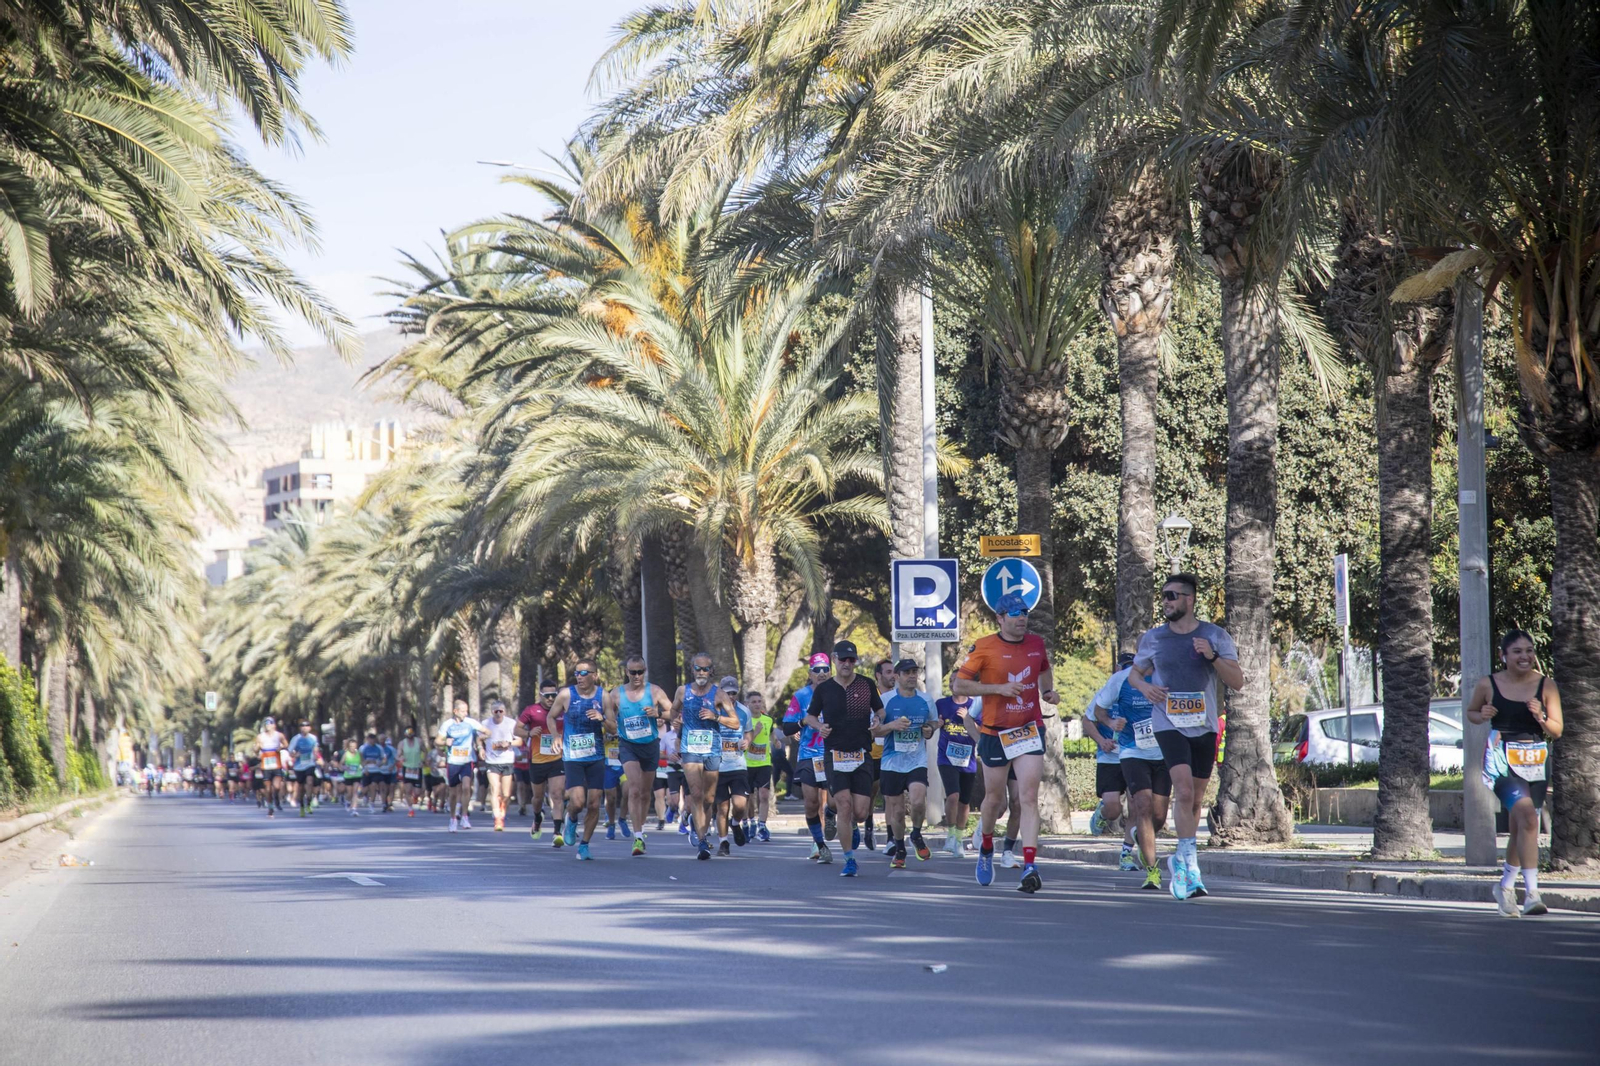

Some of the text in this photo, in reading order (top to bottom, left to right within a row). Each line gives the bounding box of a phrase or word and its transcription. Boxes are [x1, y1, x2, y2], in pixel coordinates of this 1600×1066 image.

[898, 564, 951, 627] P
[915, 616, 935, 627] 24h
[911, 631, 930, 639] LÓPEZ
[932, 630, 955, 638] FALCÓN
[1171, 699, 1202, 710] 2606
[897, 731, 919, 740] 1202
[1516, 749, 1541, 762] 181
